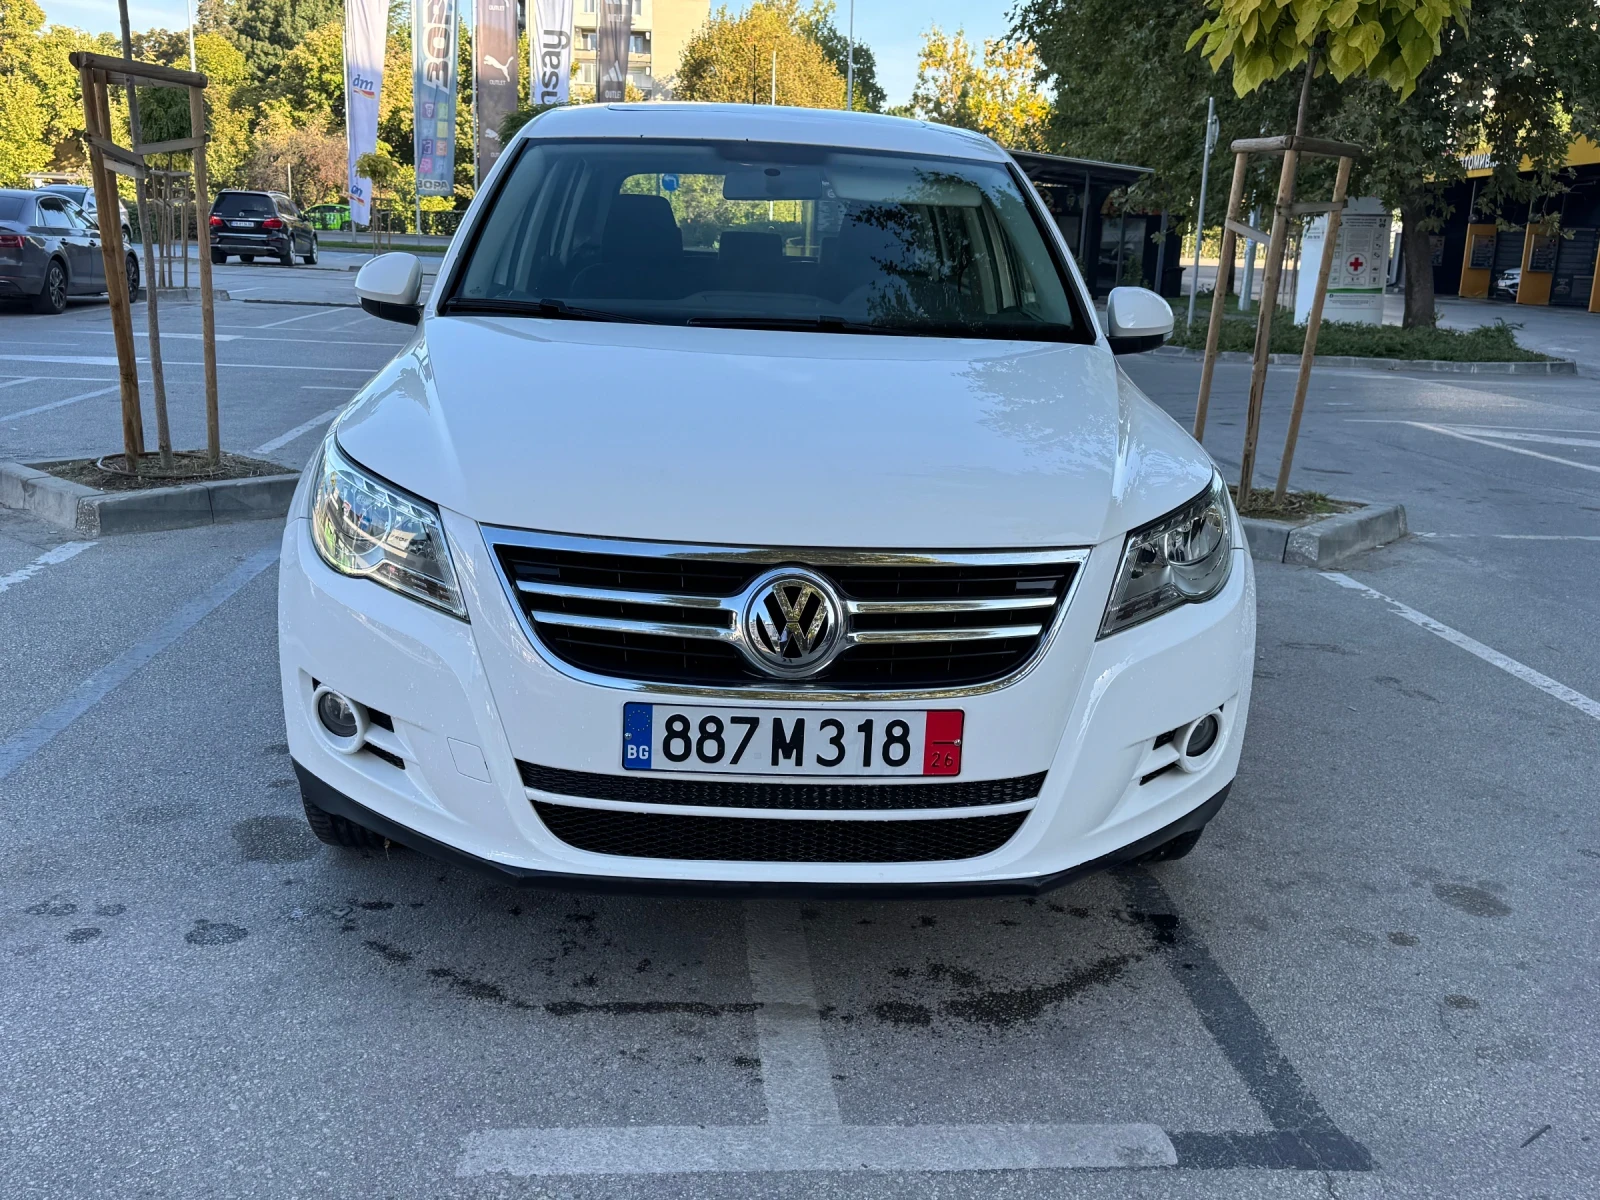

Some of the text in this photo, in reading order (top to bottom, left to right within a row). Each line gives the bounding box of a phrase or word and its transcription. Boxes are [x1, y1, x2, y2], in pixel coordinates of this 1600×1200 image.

[424, 0, 451, 91] ЗОР
[353, 74, 374, 91] dm
[662, 714, 911, 767] 887 M 318
[628, 744, 649, 759] BG
[931, 751, 954, 768] 26
